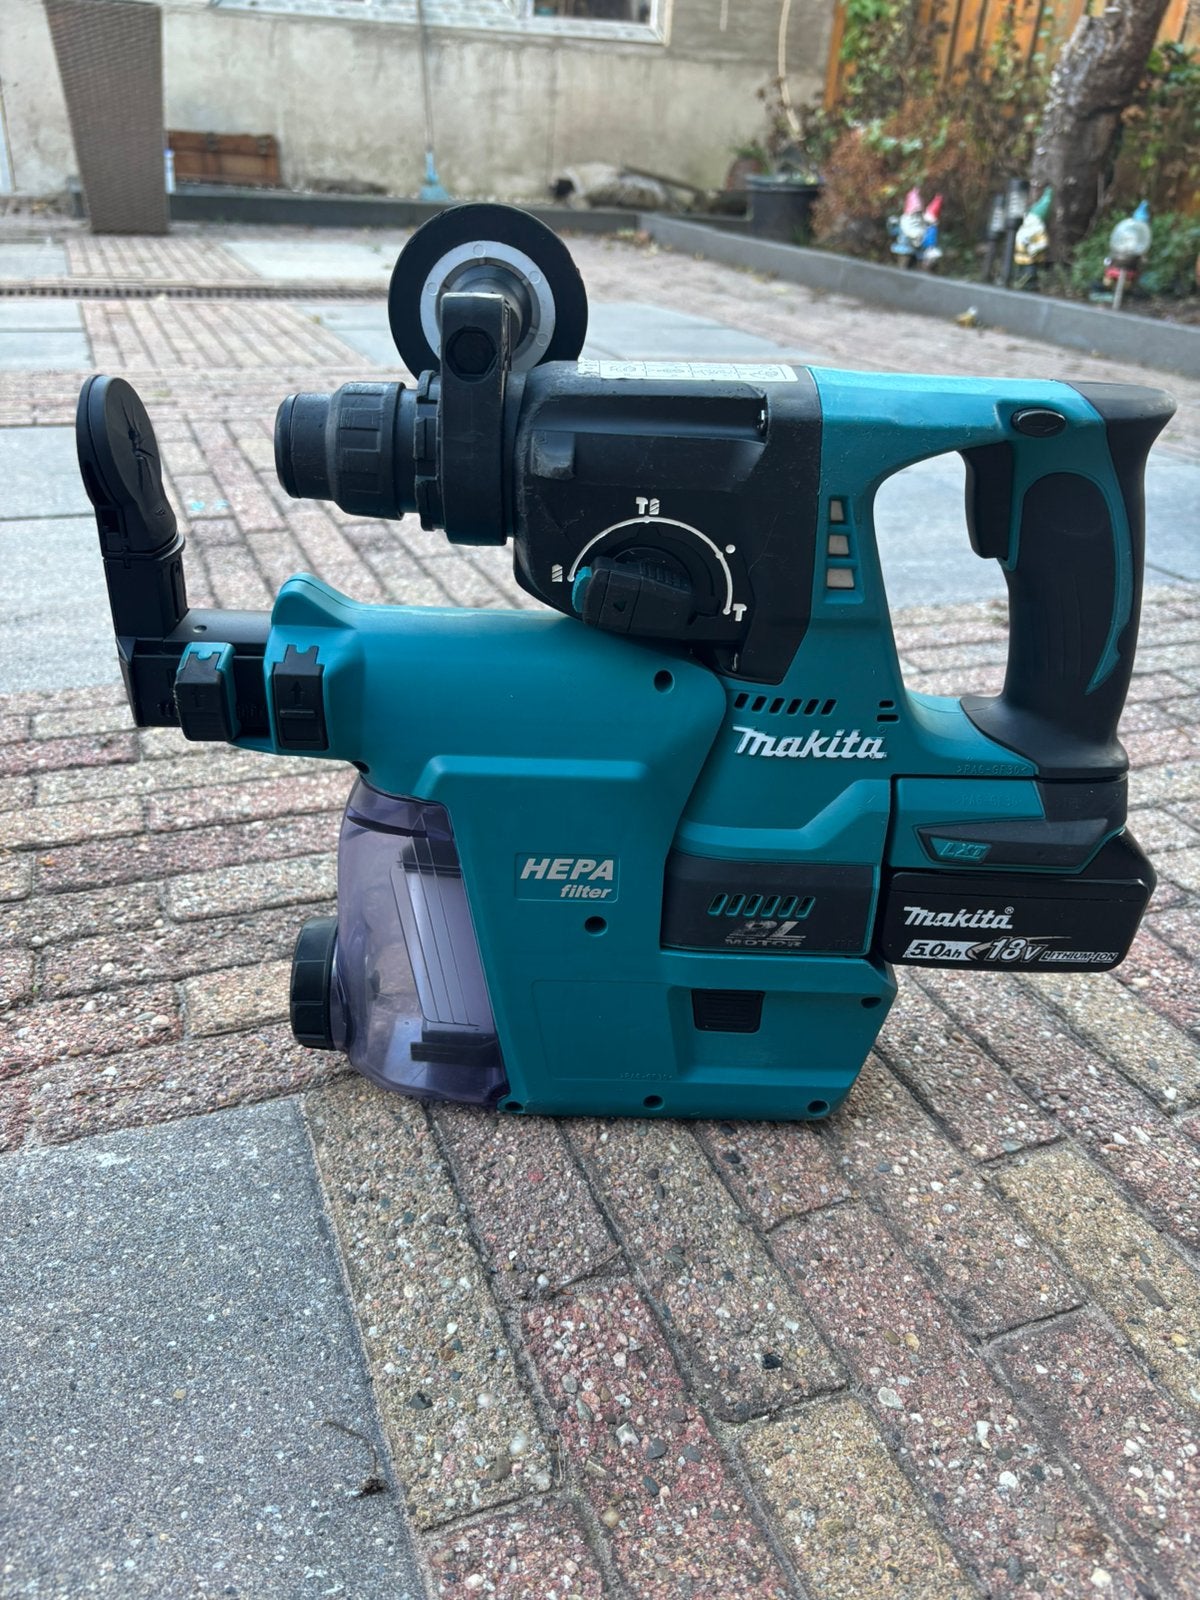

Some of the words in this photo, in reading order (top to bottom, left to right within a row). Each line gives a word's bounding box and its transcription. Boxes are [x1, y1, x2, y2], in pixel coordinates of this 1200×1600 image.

[520, 858, 614, 881] HEPA
[560, 884, 612, 898] filter
[725, 938, 802, 948] MOTOR
[986, 937, 1046, 962] 18V
[1040, 951, 1119, 963] LITHIUM-ION
